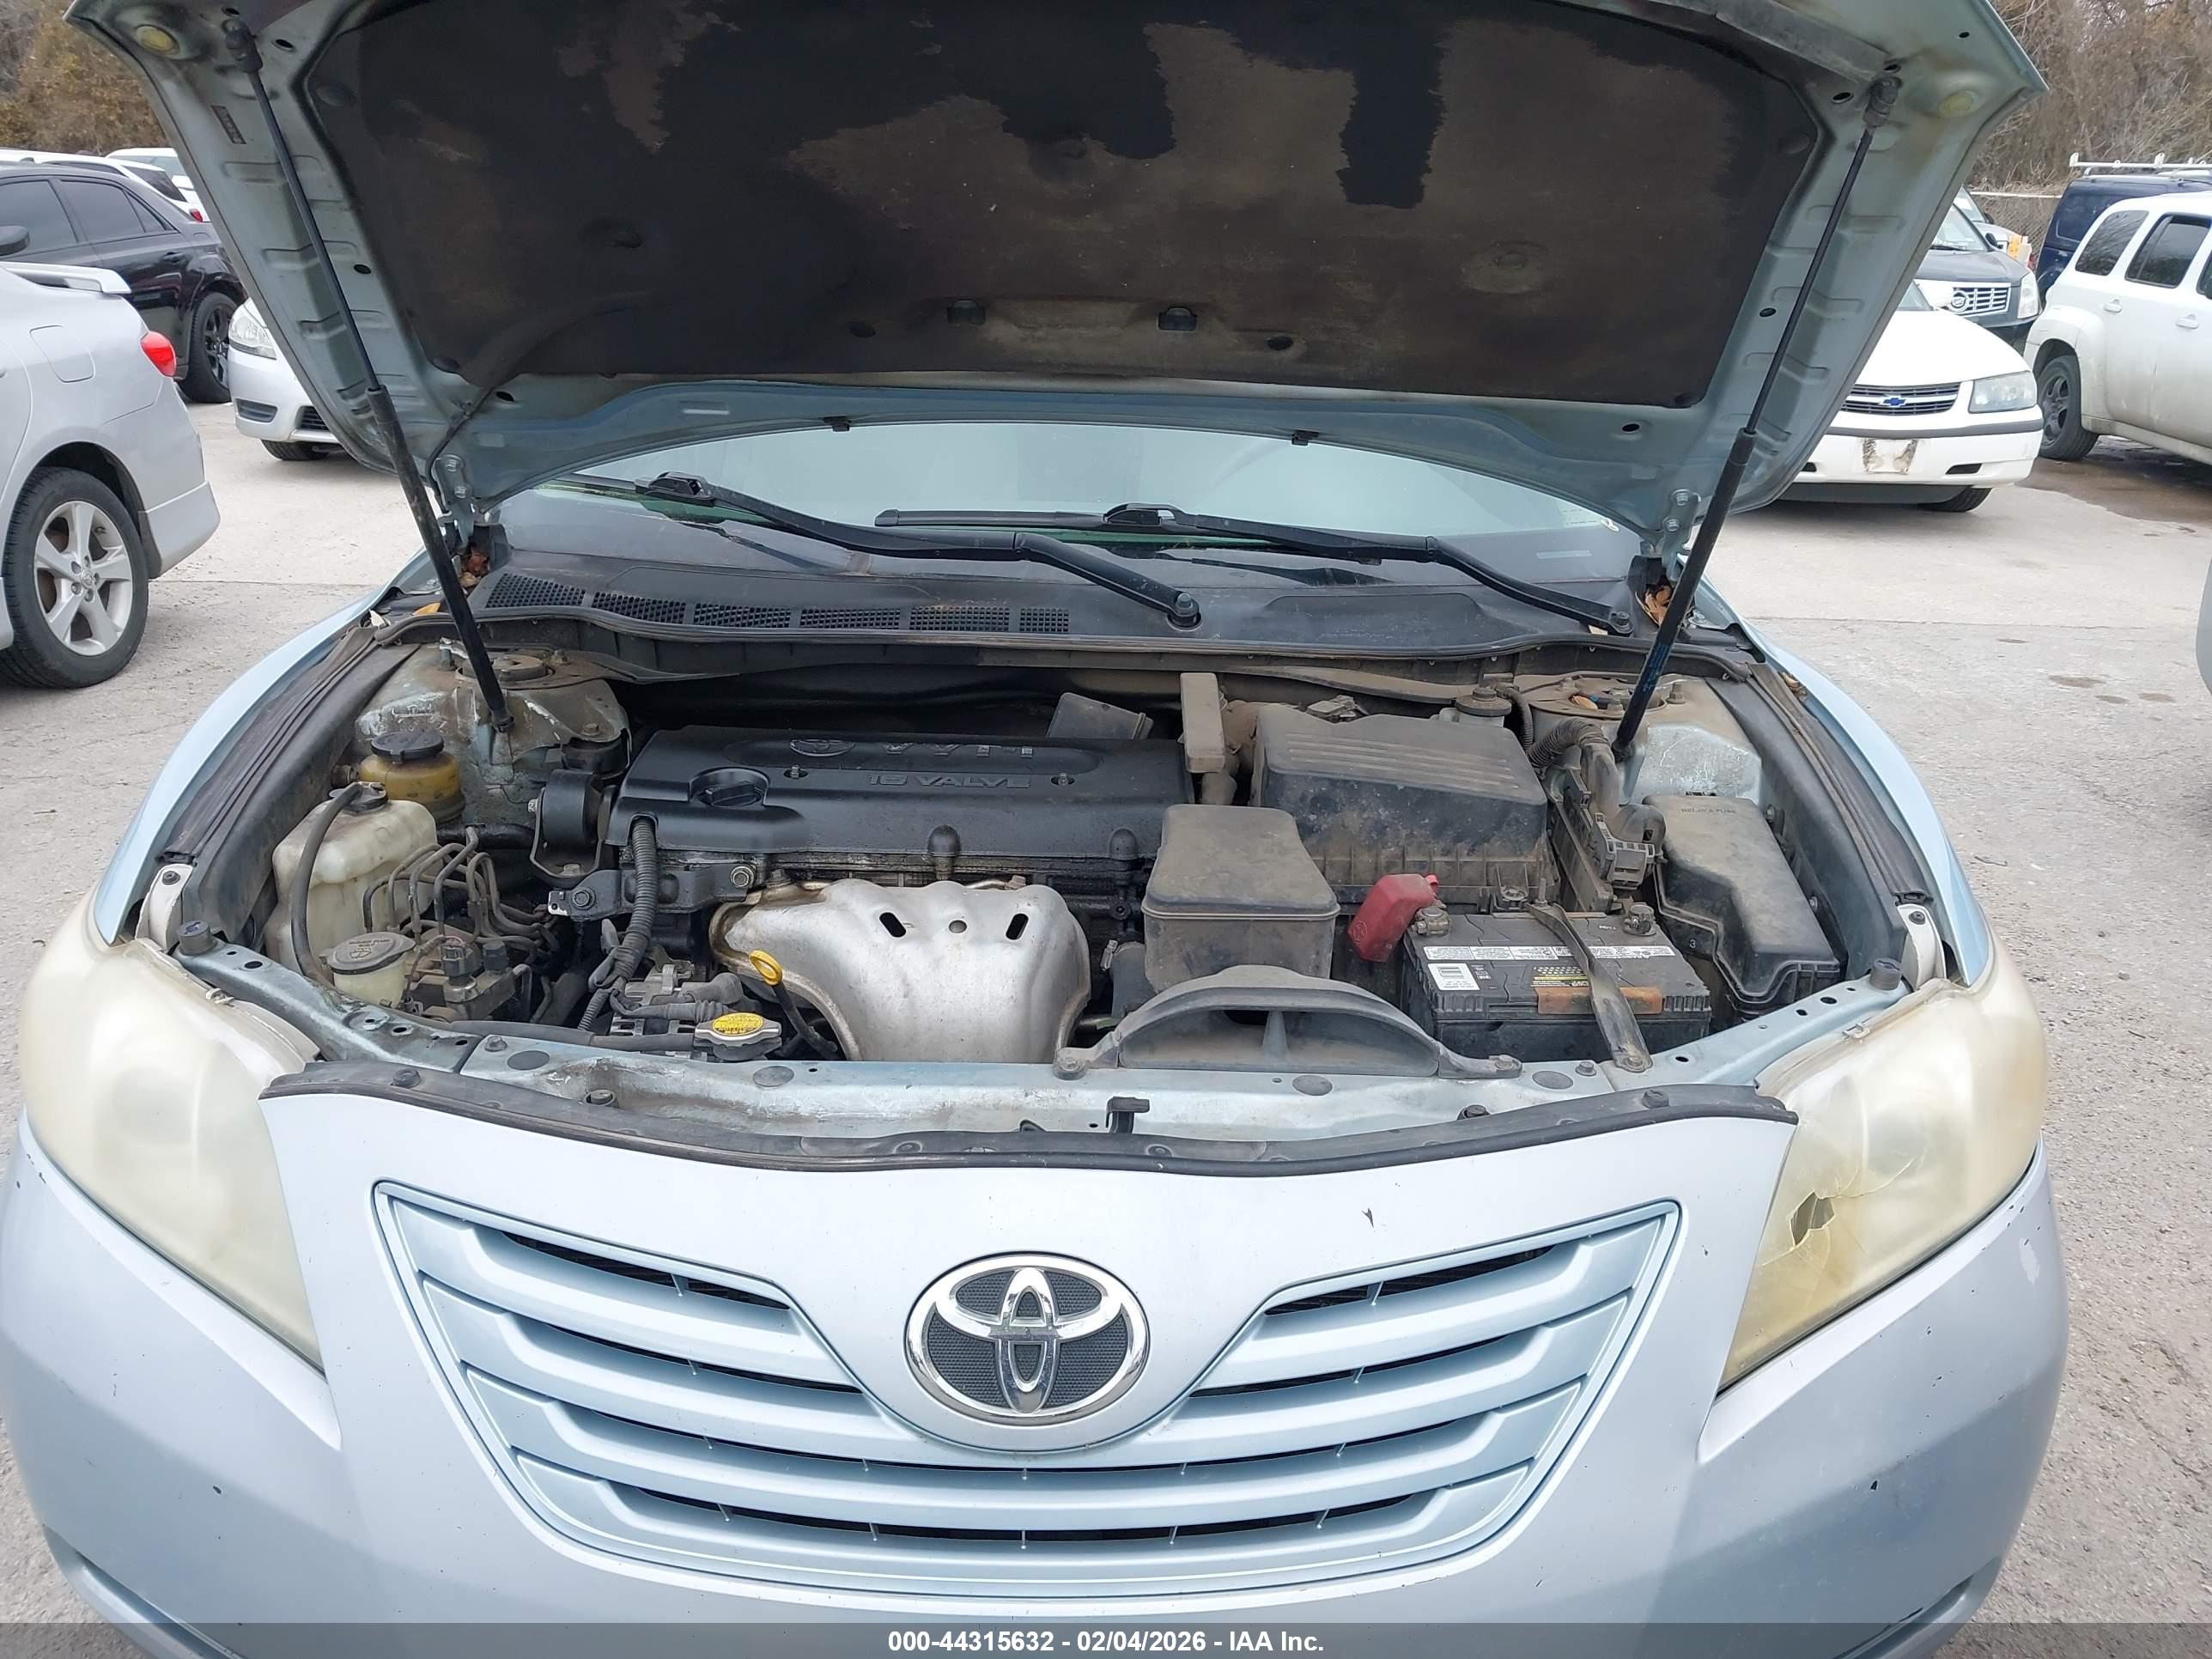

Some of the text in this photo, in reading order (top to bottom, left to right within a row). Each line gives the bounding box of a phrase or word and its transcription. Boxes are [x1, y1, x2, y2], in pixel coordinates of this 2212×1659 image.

[866, 774, 1030, 789] 16 VALVE
[1689, 939, 1697, 949] 3
